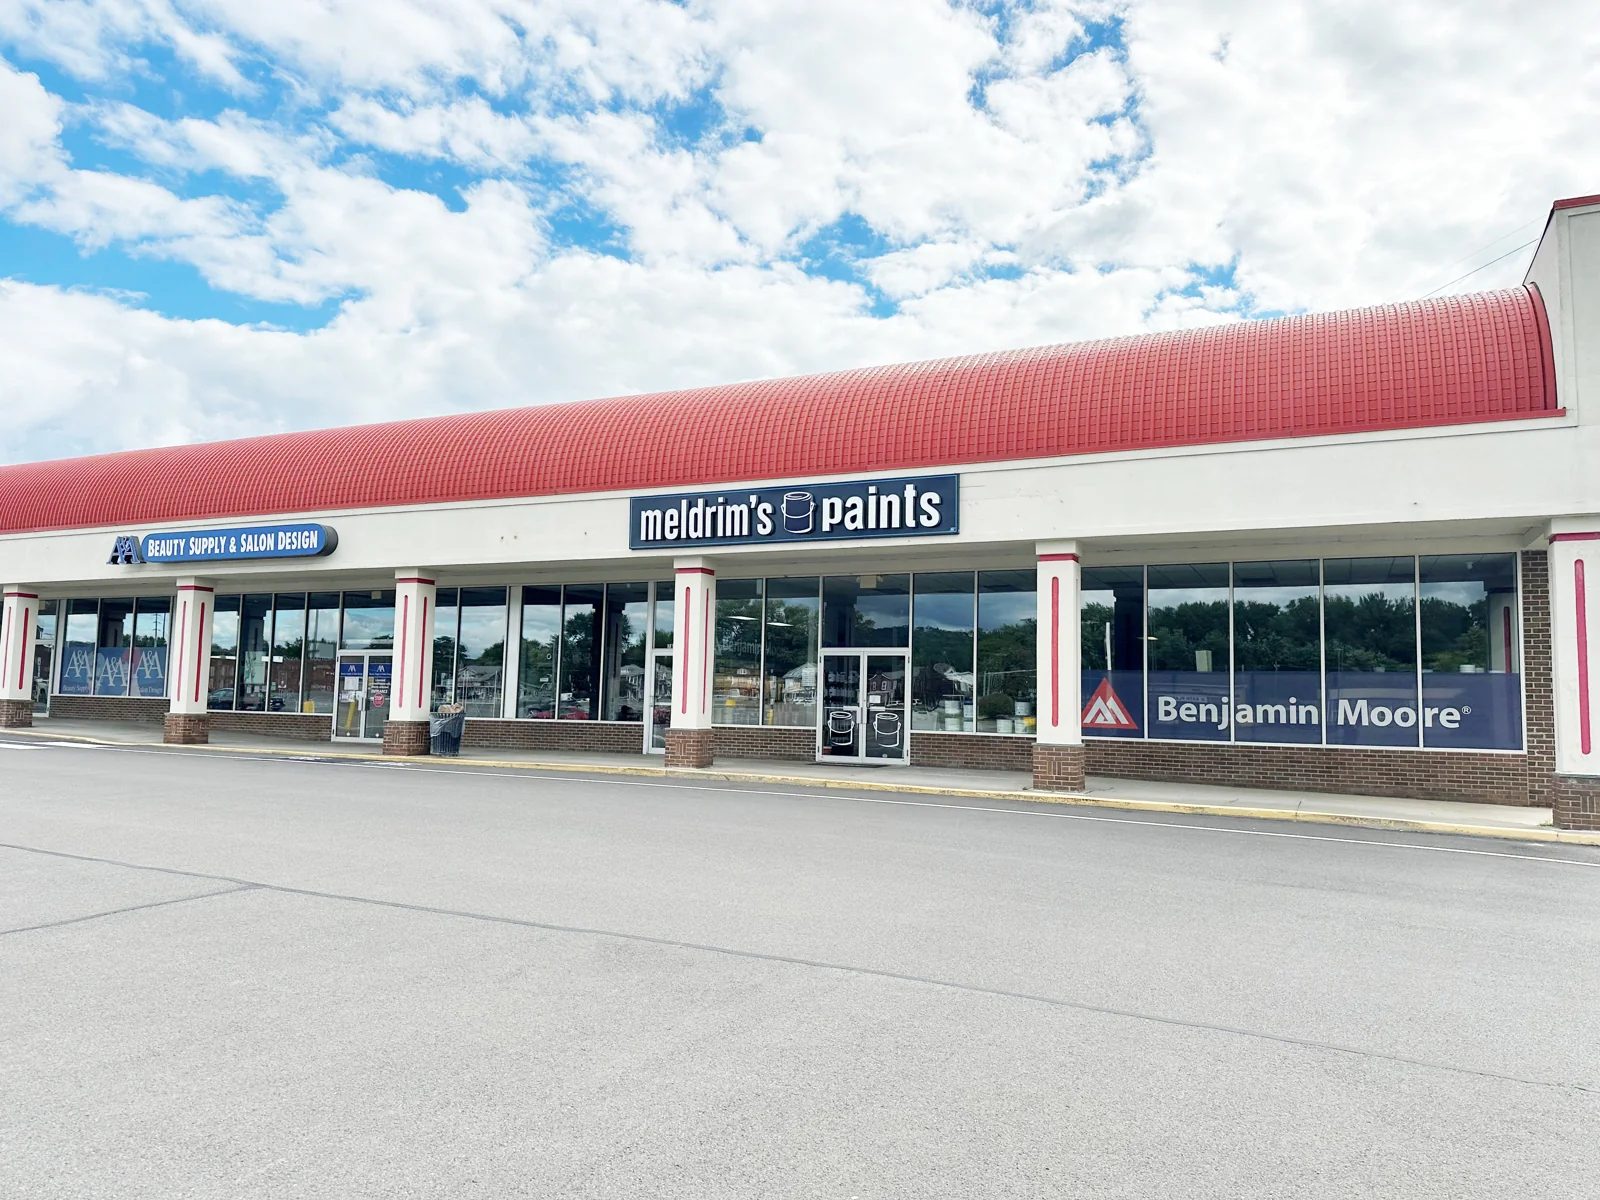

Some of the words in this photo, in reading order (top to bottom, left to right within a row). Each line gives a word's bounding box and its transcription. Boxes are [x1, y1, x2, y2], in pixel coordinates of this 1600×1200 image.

[640, 495, 774, 540] meldrim's
[822, 484, 941, 532] paints
[147, 539, 186, 557] BEAUTY
[189, 536, 227, 555] SUPPLY
[229, 536, 237, 552] &
[240, 533, 275, 551] SALON
[277, 530, 318, 550] DESIGN
[1158, 696, 1319, 731] Benjamin
